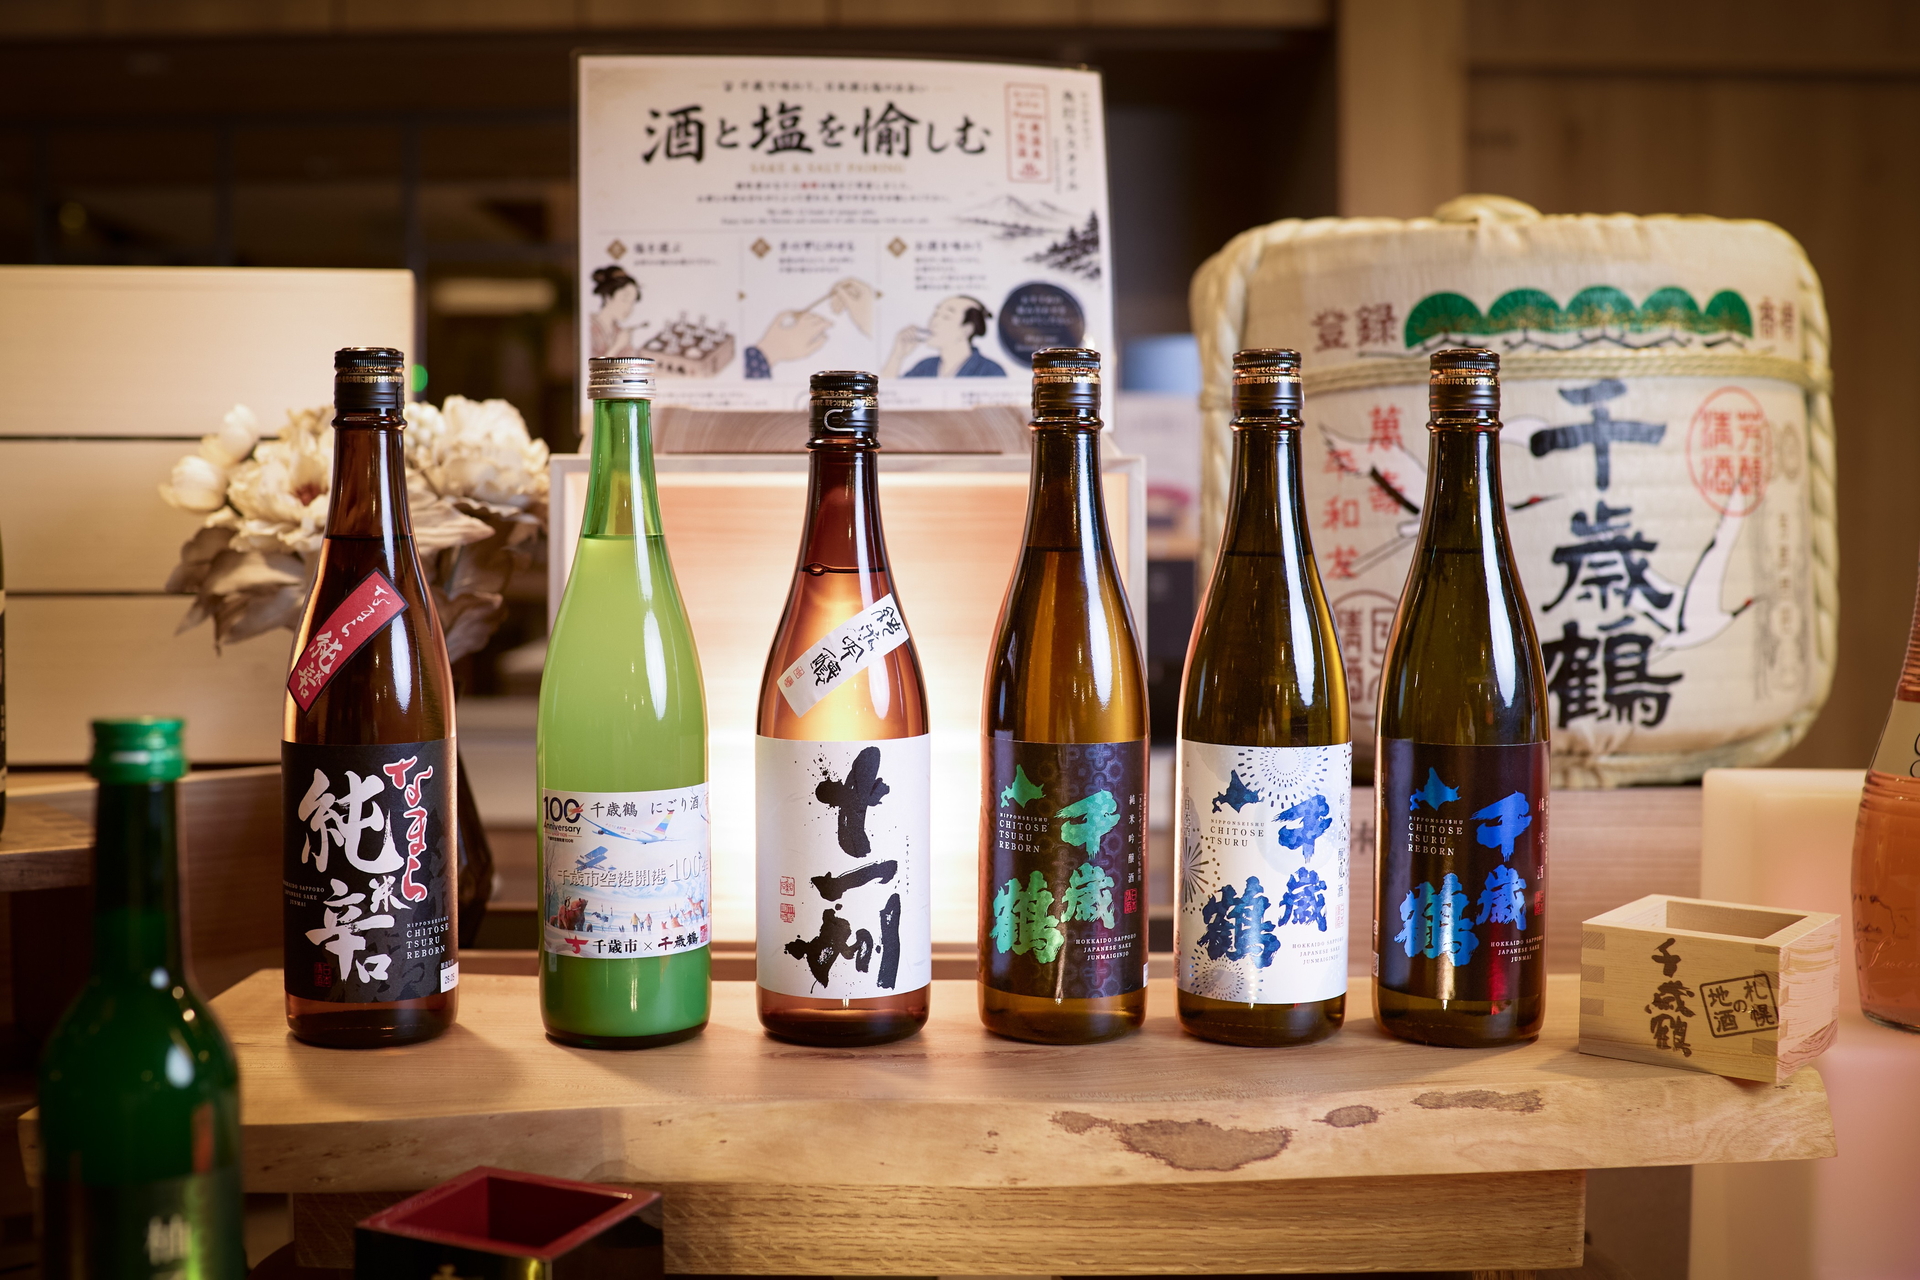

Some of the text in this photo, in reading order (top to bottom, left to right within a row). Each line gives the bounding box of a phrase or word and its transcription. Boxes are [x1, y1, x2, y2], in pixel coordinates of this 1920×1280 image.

[642, 101, 992, 164] 酒と塩を愉しむ
[1312, 304, 1395, 351] 登録
[1531, 378, 1685, 729] 千歳鶴
[342, 585, 390, 637] なまら
[810, 606, 901, 687] 純米吟醸
[297, 630, 343, 699] 純米辛口
[544, 796, 581, 823] 100
[590, 795, 699, 818] 千歳鶴 にごり酒
[999, 812, 1048, 822] NIPPONSEISHU
[1210, 819, 1265, 827] NIPPONSEISHU
[1408, 815, 1464, 825] NIPPONSEISHU
[383, 756, 433, 902] なまら
[544, 820, 581, 835] Anniversary
[999, 819, 1048, 833] CHITOSE
[1210, 826, 1264, 838] CHITOSE
[1408, 822, 1463, 835] CHITOSE
[998, 830, 1032, 842] TSURU
[1209, 836, 1248, 847] TSURU
[1407, 833, 1446, 845] TSURU
[999, 840, 1040, 853] REBORN
[1407, 843, 1455, 856] REBORN
[784, 746, 902, 992] 十一州
[298, 768, 412, 984] 純米辛口
[299, 883, 325, 893] SAPPORO
[289, 899, 306, 908] JUNMAI
[303, 893, 318, 901] SAKE
[406, 922, 450, 938] CHITOSE
[405, 936, 440, 949] TSURU
[592, 938, 638, 954] 千歳市
[658, 930, 699, 951] 千歳鶴
[1075, 933, 1137, 945] HOKKAIDO SAPPORO
[1292, 941, 1325, 949] HOKKAIDO
[1490, 935, 1544, 948] HOKKAIDO SAPPORO
[406, 945, 446, 960] REBORN
[1083, 942, 1132, 953] JAPANESE SAKE
[1300, 948, 1329, 957] JAPANESE
[1498, 947, 1528, 956] JAPANESE
[1087, 951, 1130, 961] JUNMAIGINJO
[1511, 954, 1532, 963] JUNMAI
[1645, 937, 1696, 1057] 千歳鶴
[1707, 979, 1776, 1033] 札幌の地酒
